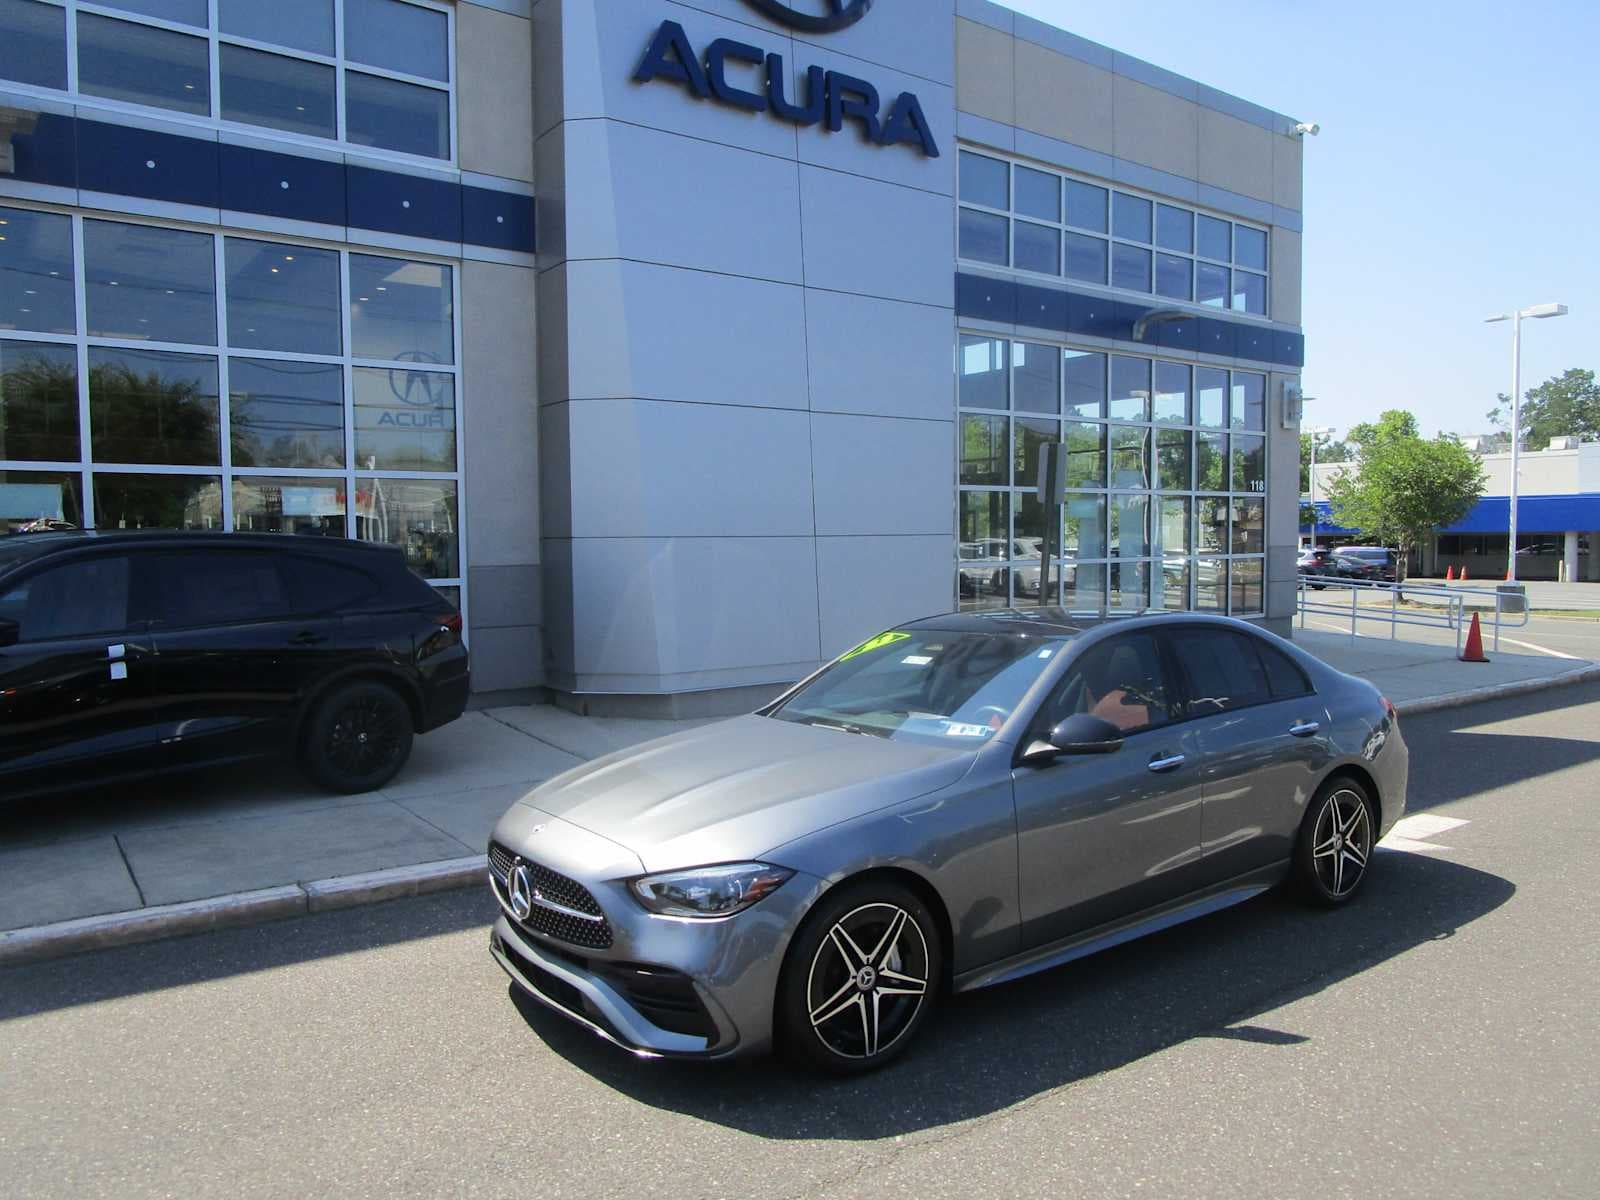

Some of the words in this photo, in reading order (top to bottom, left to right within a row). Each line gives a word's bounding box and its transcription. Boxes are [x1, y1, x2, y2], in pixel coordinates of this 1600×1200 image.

[632, 20, 939, 158] ACURA
[377, 411, 445, 427] ACUR
[1250, 480, 1264, 492] 118
